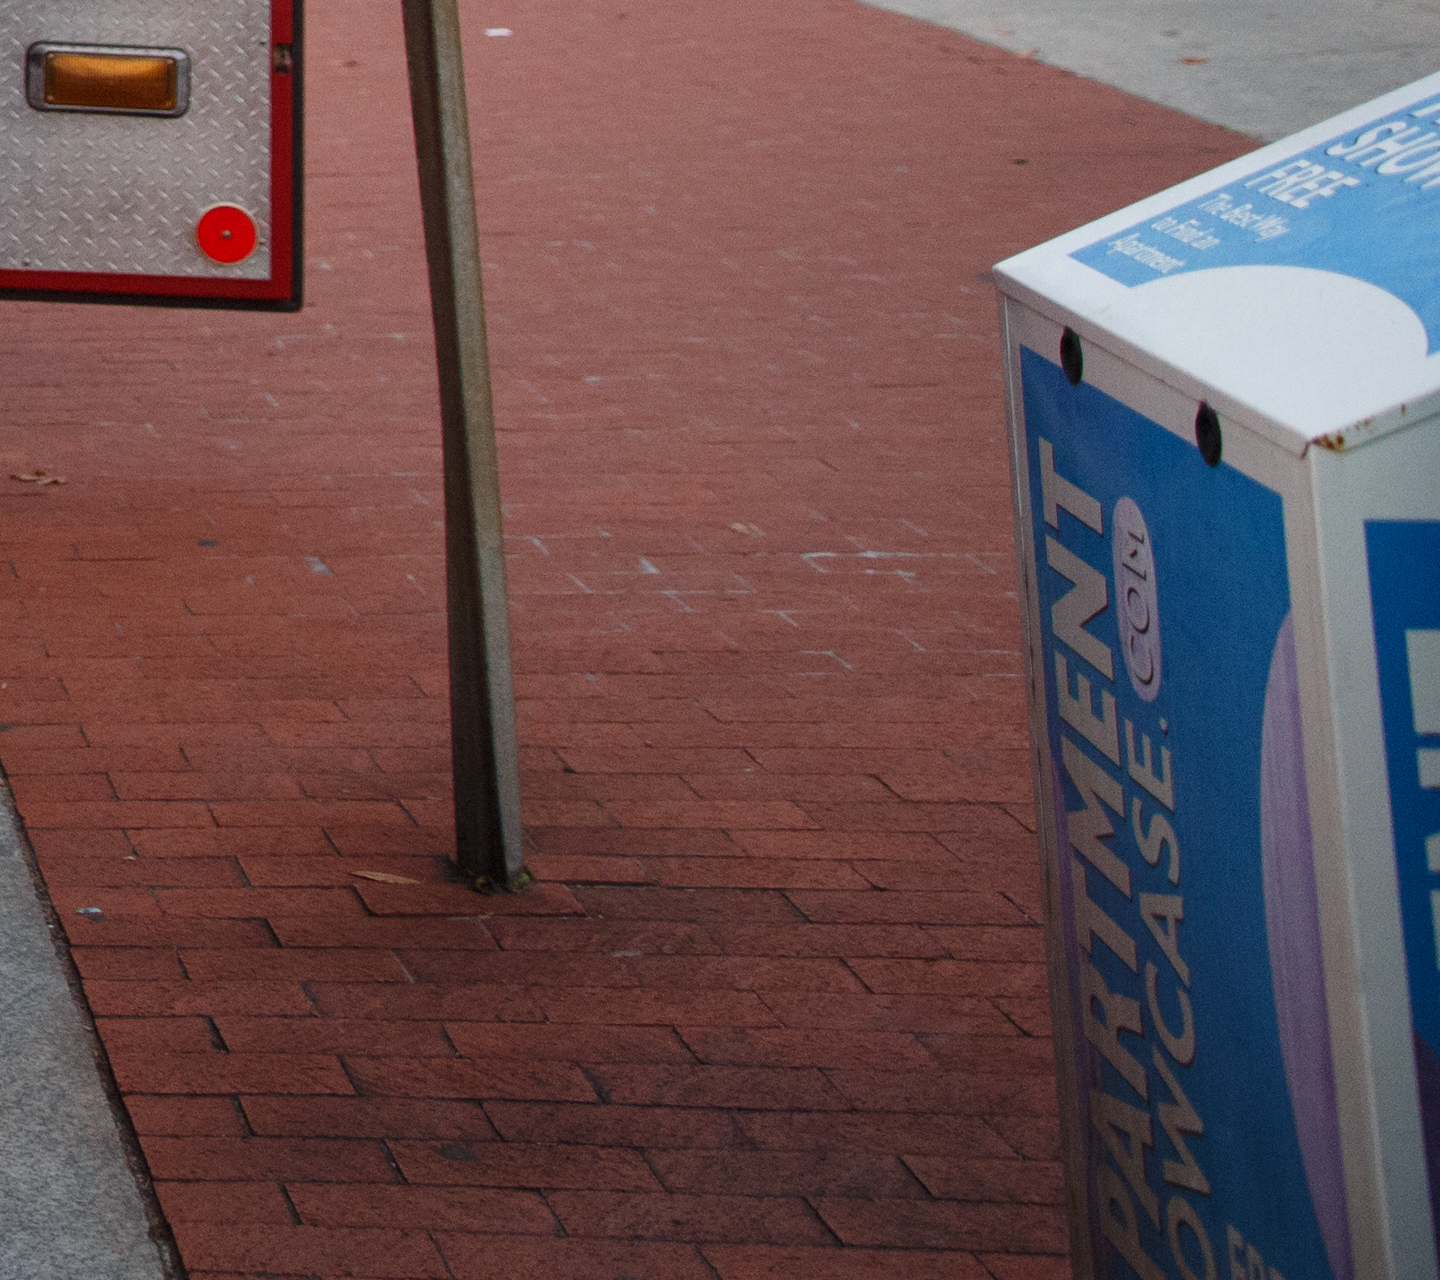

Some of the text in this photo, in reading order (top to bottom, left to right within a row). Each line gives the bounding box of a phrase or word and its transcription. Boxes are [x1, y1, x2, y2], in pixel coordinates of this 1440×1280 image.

[1244, 159, 1361, 209] FREE
[1197, 193, 1290, 242] The Best Way
[1106, 232, 1186, 274] Apartment
[1122, 531, 1156, 686] COM
